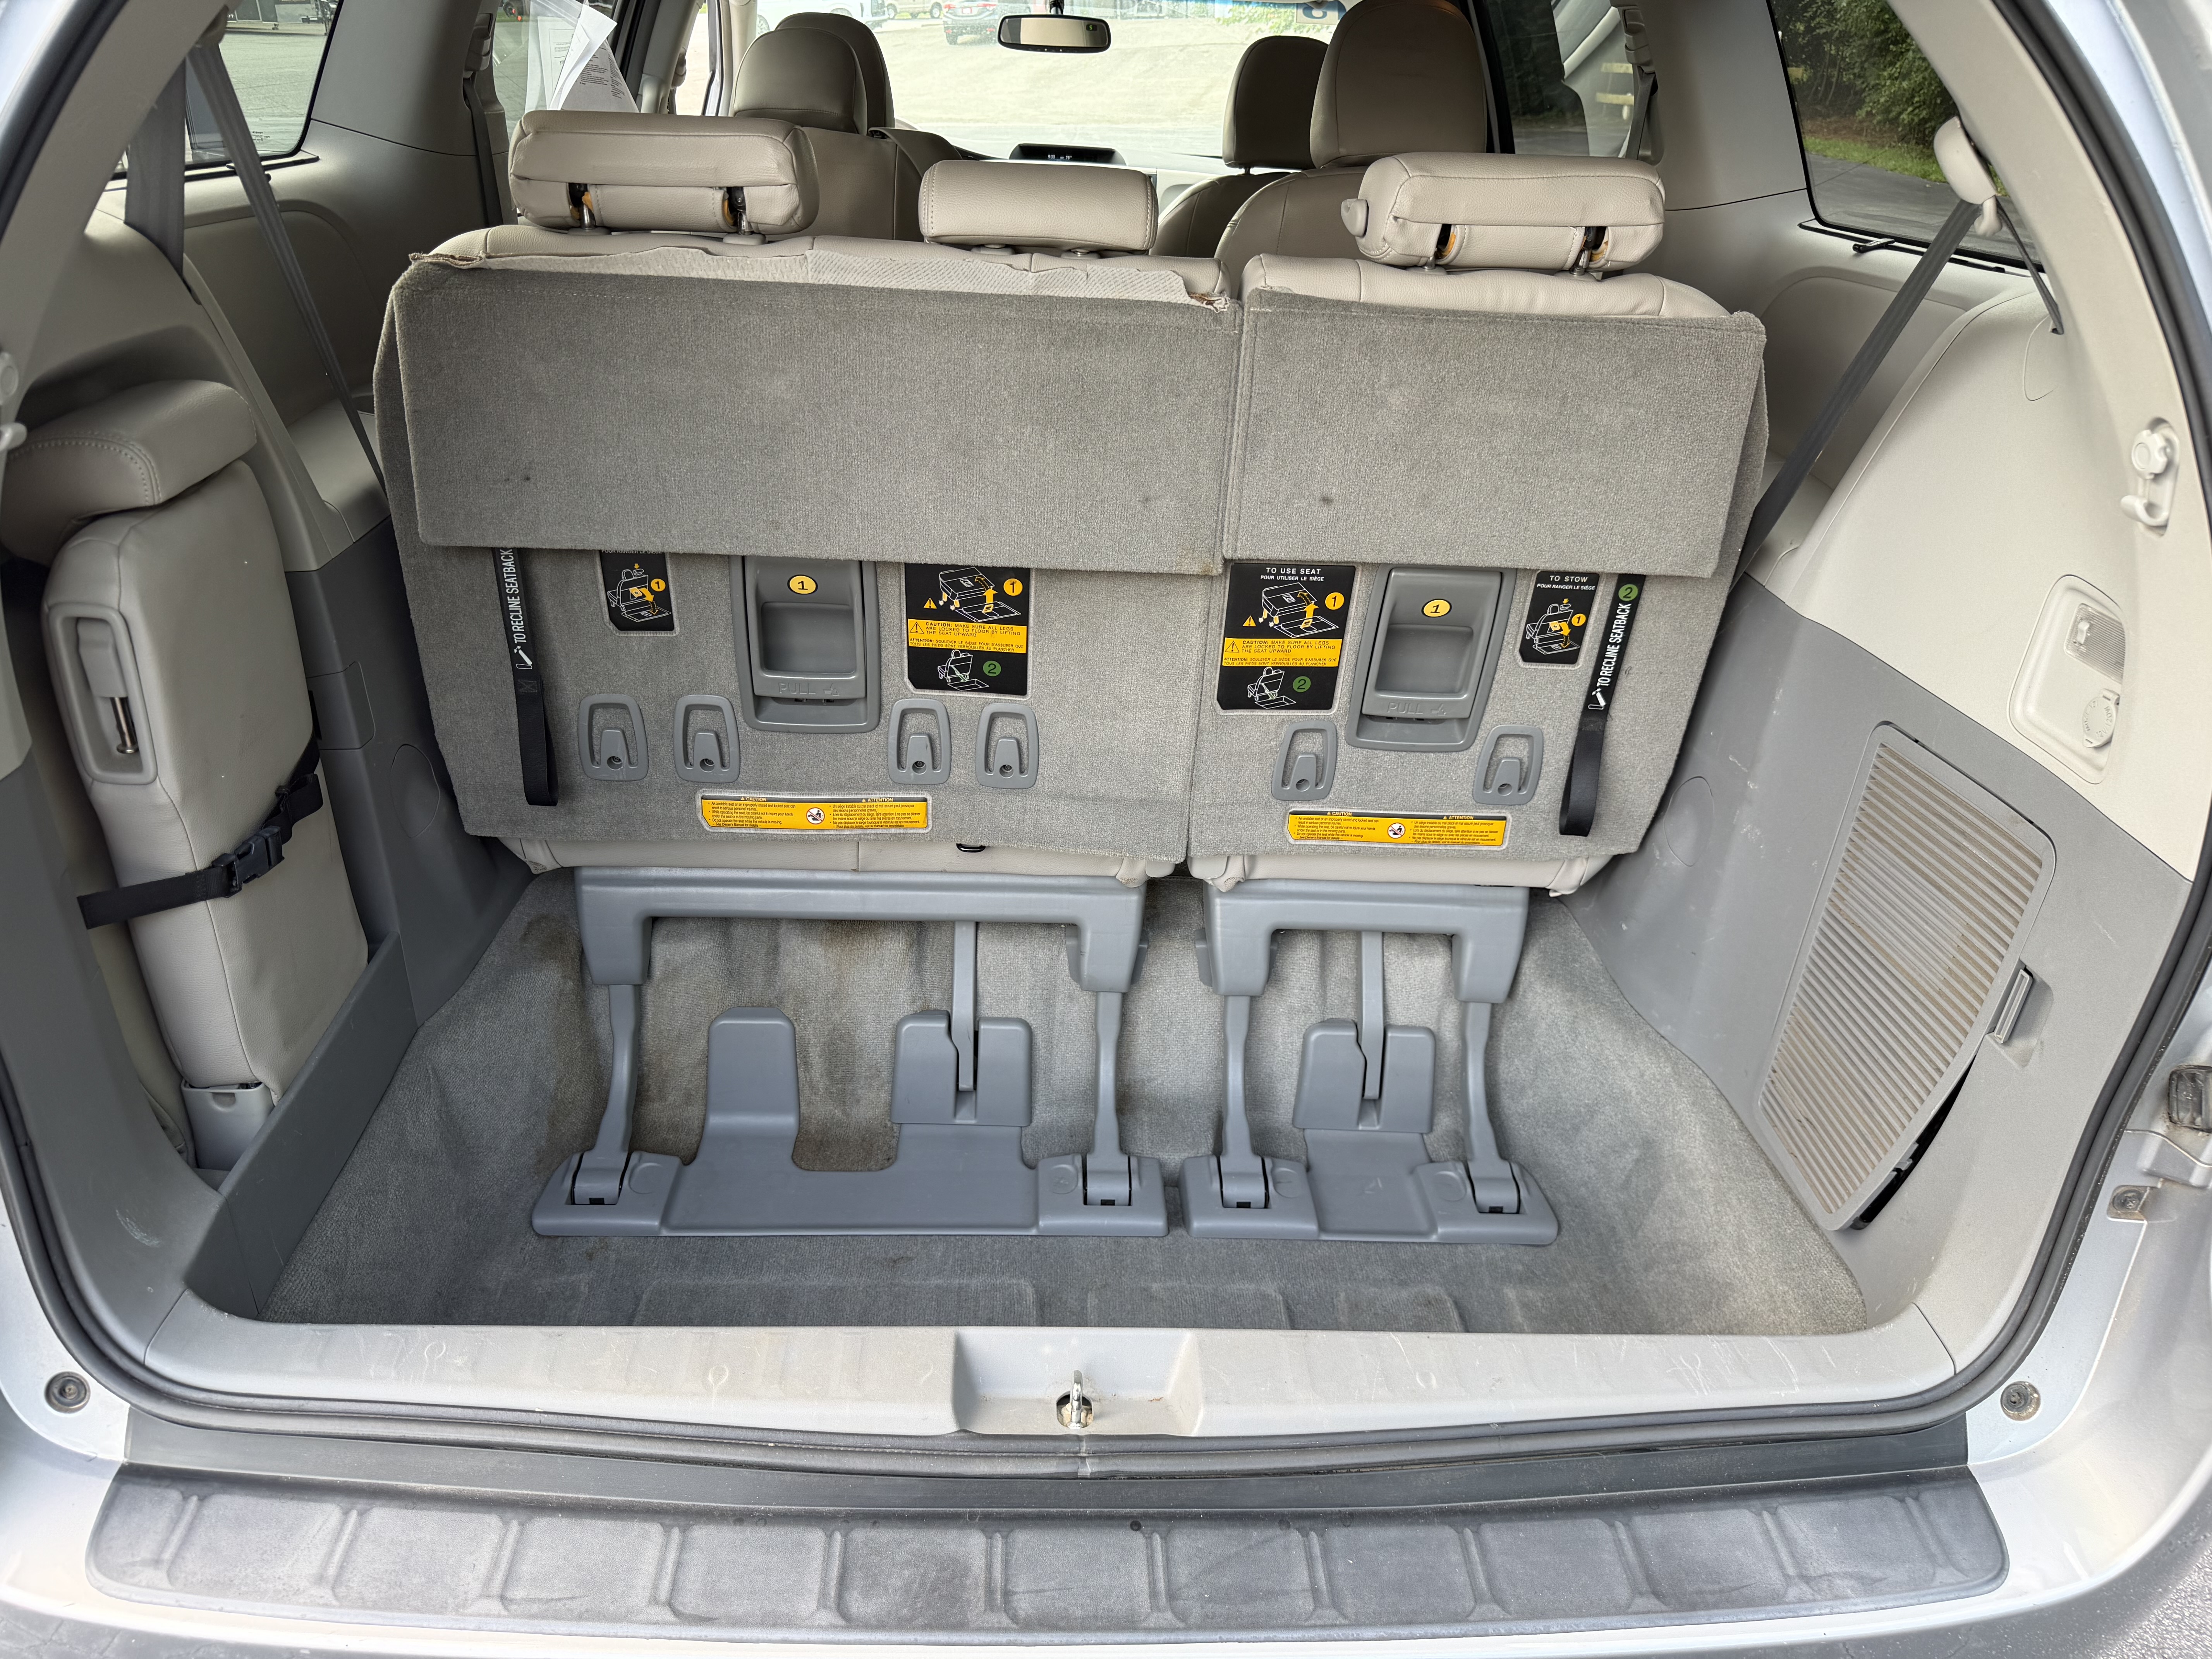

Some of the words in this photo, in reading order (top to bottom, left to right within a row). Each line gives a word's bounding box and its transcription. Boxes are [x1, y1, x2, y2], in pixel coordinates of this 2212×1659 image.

[500, 549, 519, 594] SEATBACK
[655, 581, 660, 589] 1
[798, 580, 808, 590] 1
[1010, 581, 1014, 593] 1
[1623, 587, 1633, 599] 2
[1331, 596, 1337, 607] 1
[507, 596, 525, 631] RECLINE
[1430, 604, 1440, 613] 1
[1609, 603, 1632, 644] SEATBACK
[514, 633, 527, 644] TO
[1600, 644, 1620, 676] RECLINE
[988, 663, 996, 674] 2
[1297, 678, 1306, 690] 2
[1596, 677, 1610, 686] TO
[778, 682, 816, 695] PULL
[1387, 702, 1423, 714] PULL
